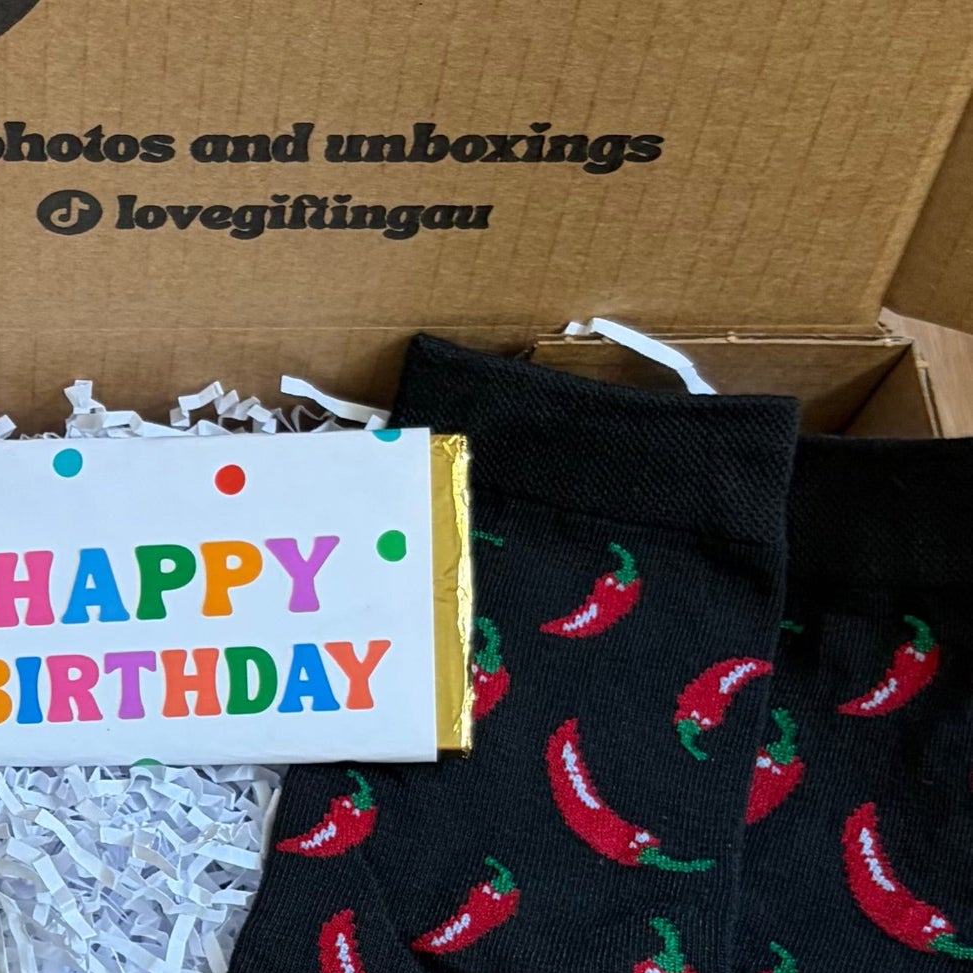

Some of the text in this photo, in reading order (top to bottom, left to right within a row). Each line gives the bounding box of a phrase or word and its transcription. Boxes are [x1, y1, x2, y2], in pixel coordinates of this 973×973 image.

[190, 122, 315, 164] and
[324, 121, 666, 175] unboxings
[114, 194, 494, 240] lovegiftingau
